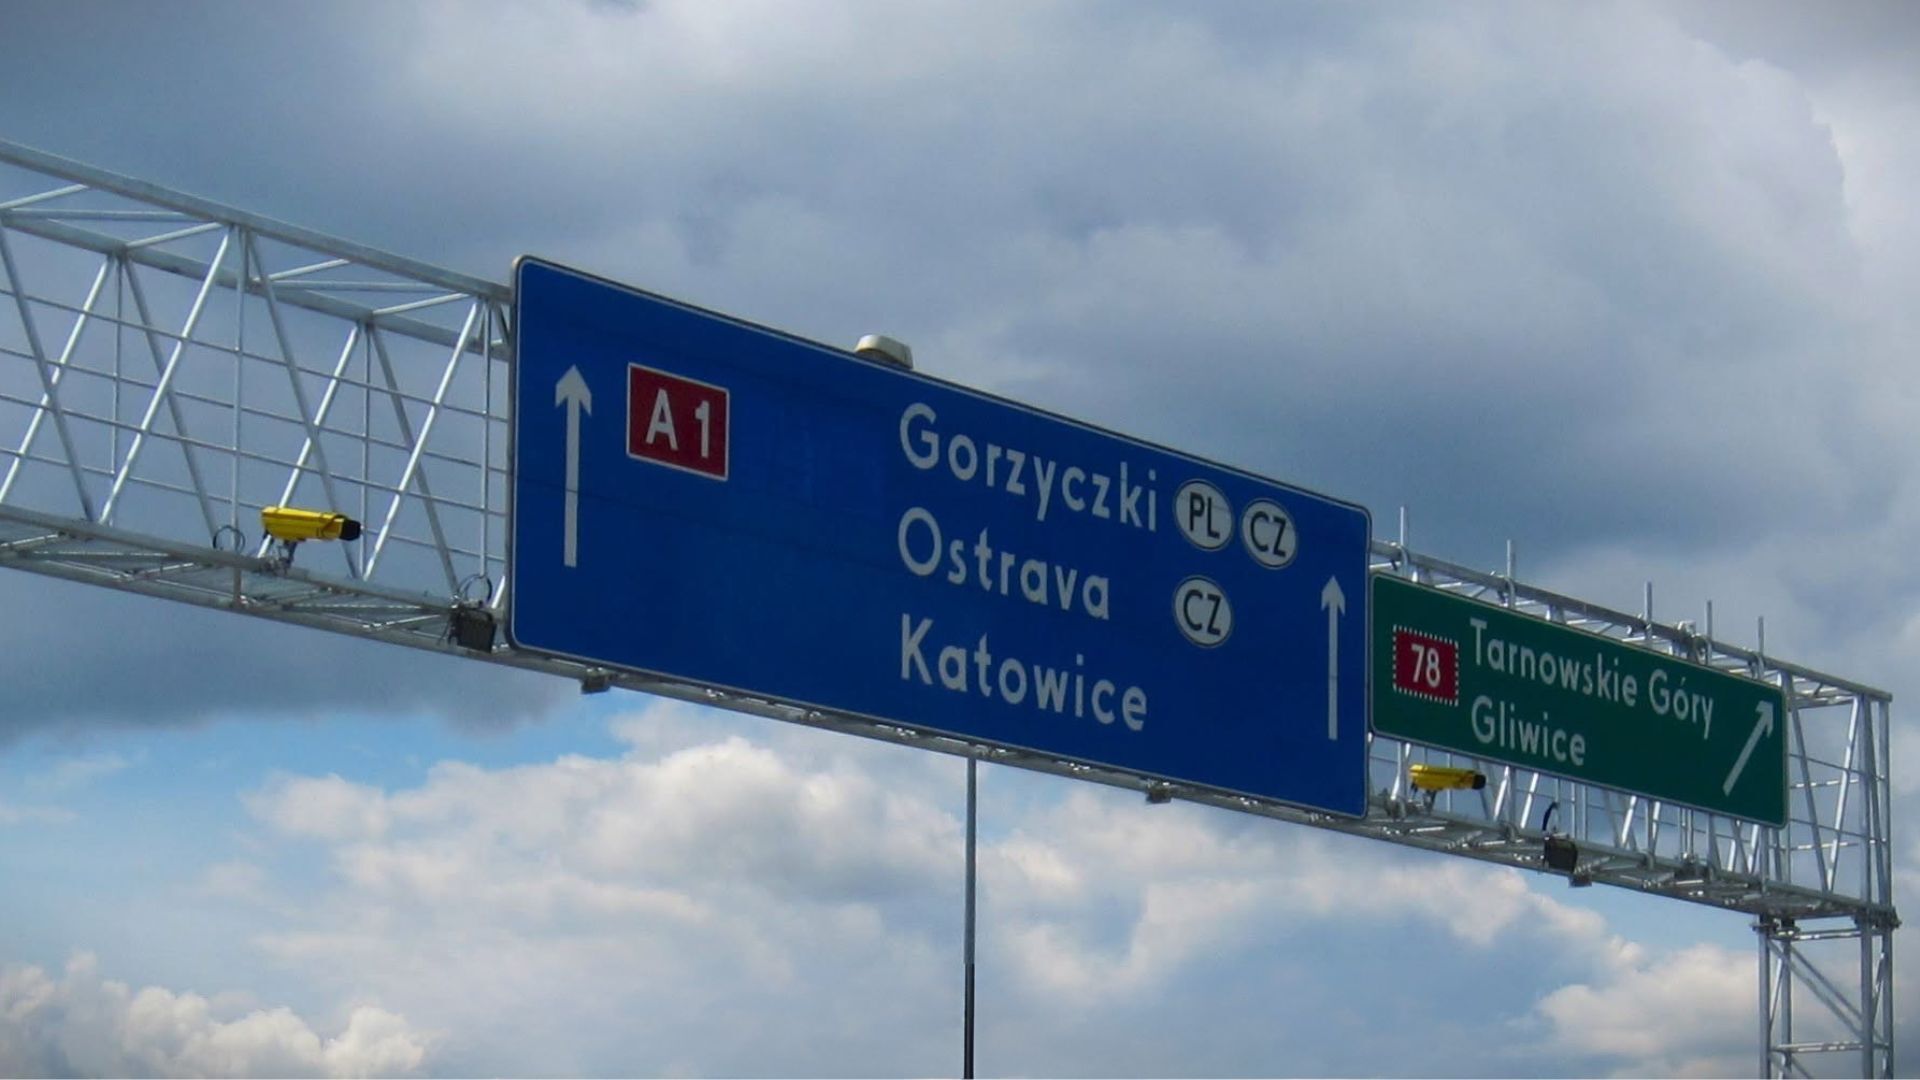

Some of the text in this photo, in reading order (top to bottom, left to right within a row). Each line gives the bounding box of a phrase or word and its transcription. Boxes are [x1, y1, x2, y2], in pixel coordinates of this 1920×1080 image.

[900, 403, 1288, 556] Gorzyczki PL CZ
[899, 508, 1222, 635] Ostrava CZ
[901, 614, 1148, 731] Katowice
[1411, 644, 1441, 687] 78
[1470, 618, 1714, 739] Tarnowskie Góry
[1472, 695, 1585, 766] Gliwice
